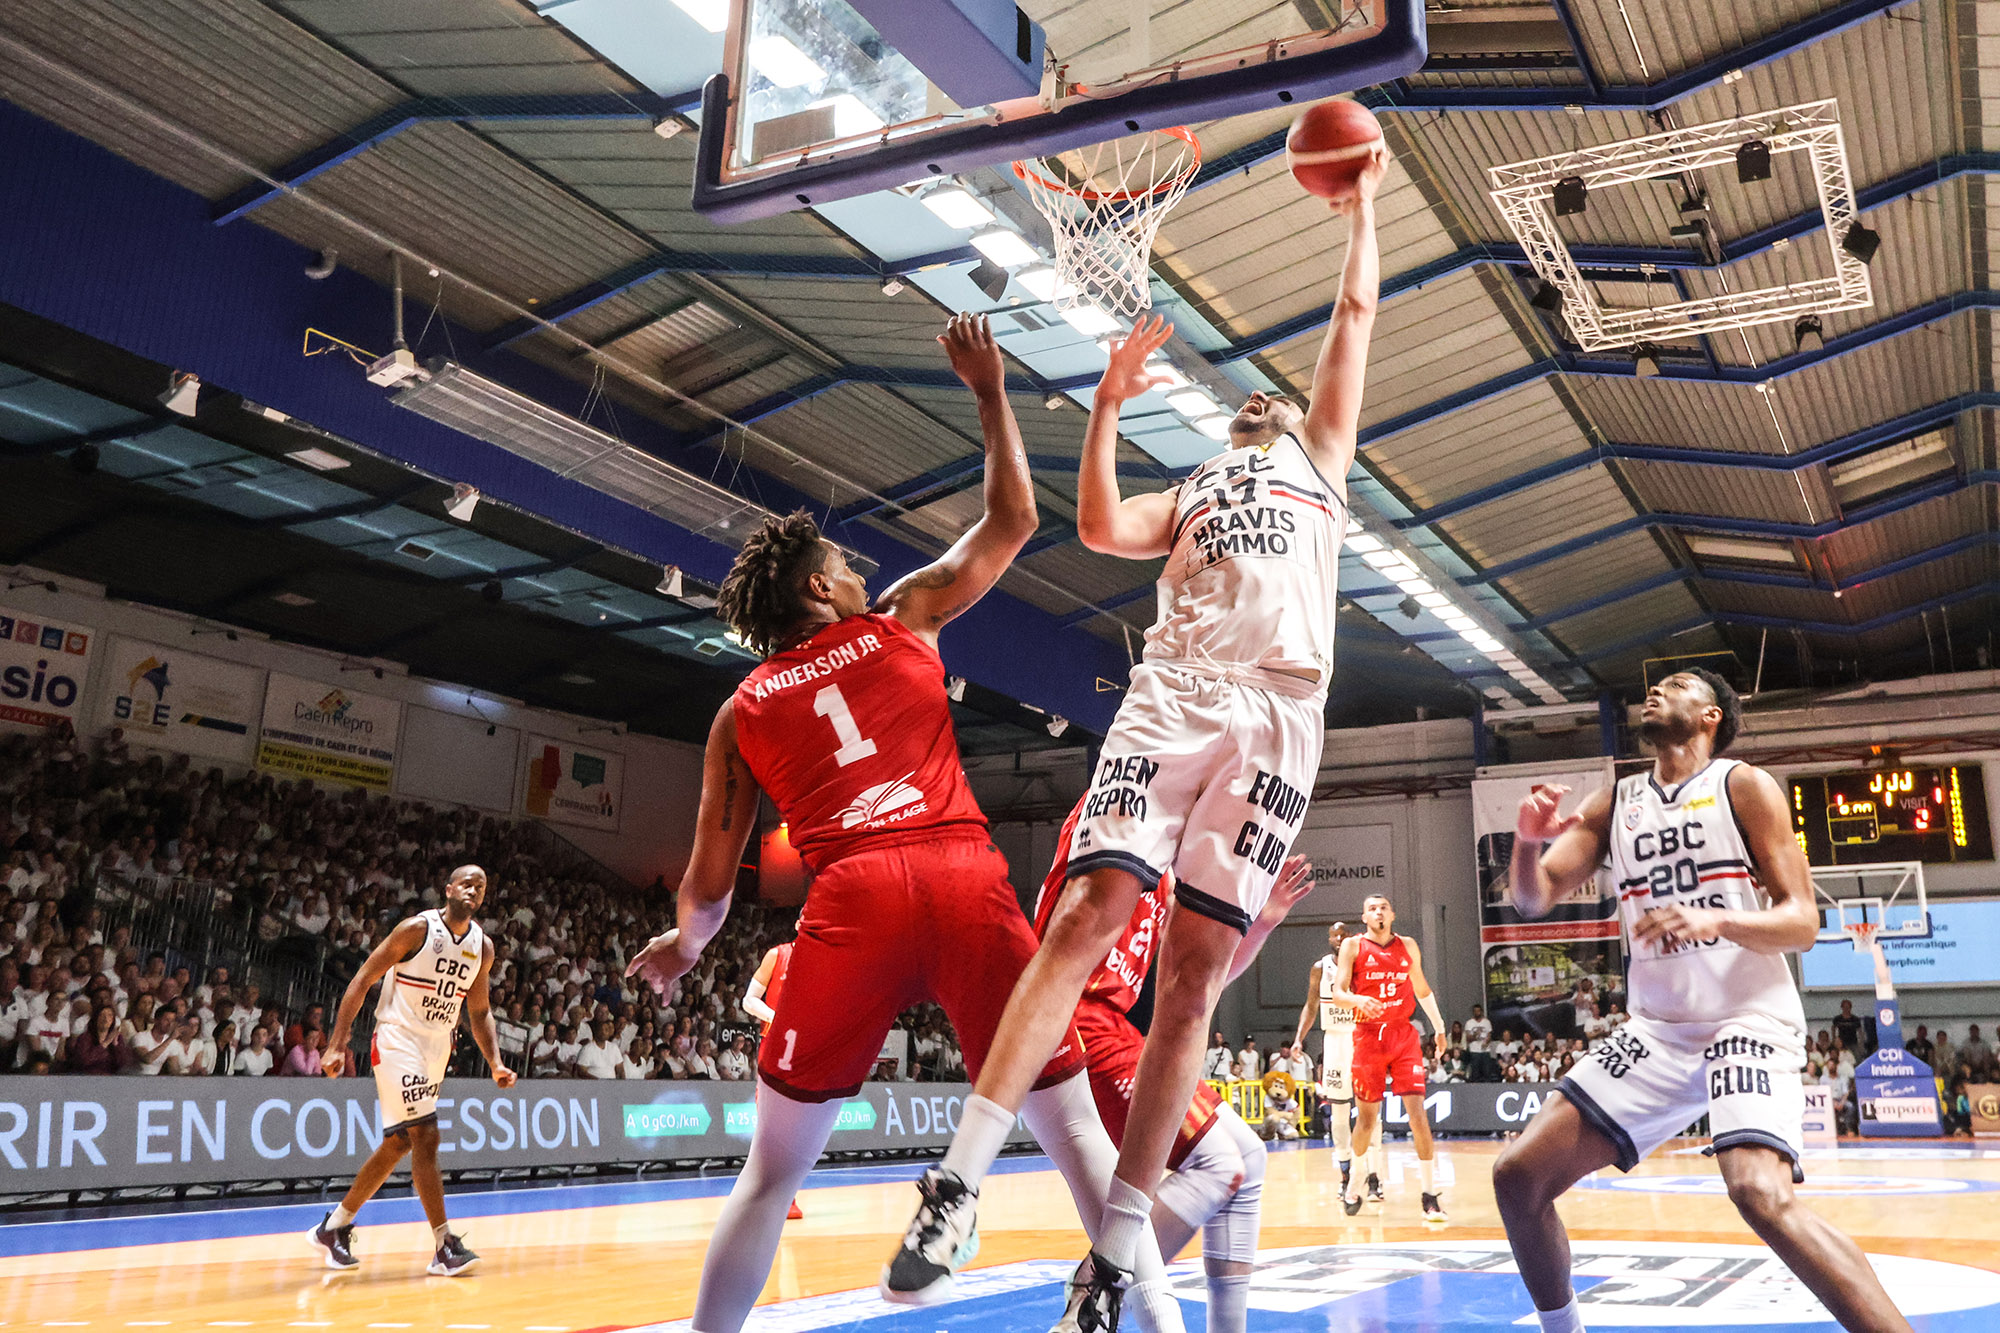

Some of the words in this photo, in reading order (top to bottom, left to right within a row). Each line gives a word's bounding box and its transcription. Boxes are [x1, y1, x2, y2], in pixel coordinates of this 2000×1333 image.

[1214, 477, 1257, 511] 17
[1192, 507, 1296, 549] BRAVIS
[1201, 533, 1288, 565] IMMO
[755, 640, 859, 703] ANDERSON
[857, 634, 883, 657] JR
[114, 695, 171, 727] S2E
[813, 683, 878, 768] 1
[1098, 755, 1160, 790] CAEN
[1084, 787, 1147, 823] REPRO
[1246, 770, 1307, 828] EQUIP
[1233, 820, 1287, 877] CLUB
[1634, 822, 1705, 862] CBC
[1649, 857, 1700, 898] 20
[435, 958, 470, 981] CBC
[437, 979, 456, 999] 10
[777, 1029, 798, 1071] 1
[1878, 1048, 1903, 1062] CDI
[1710, 1065, 1772, 1100] CLUB
[1871, 1063, 1915, 1077] Intérim
[1873, 1080, 1917, 1097] Team
[738, 1111, 750, 1125] 25
[885, 1088, 906, 1136] À
[1861, 1099, 1934, 1119] Temporis
[136, 1099, 227, 1165] EN
[251, 1098, 600, 1160] CONESSION
